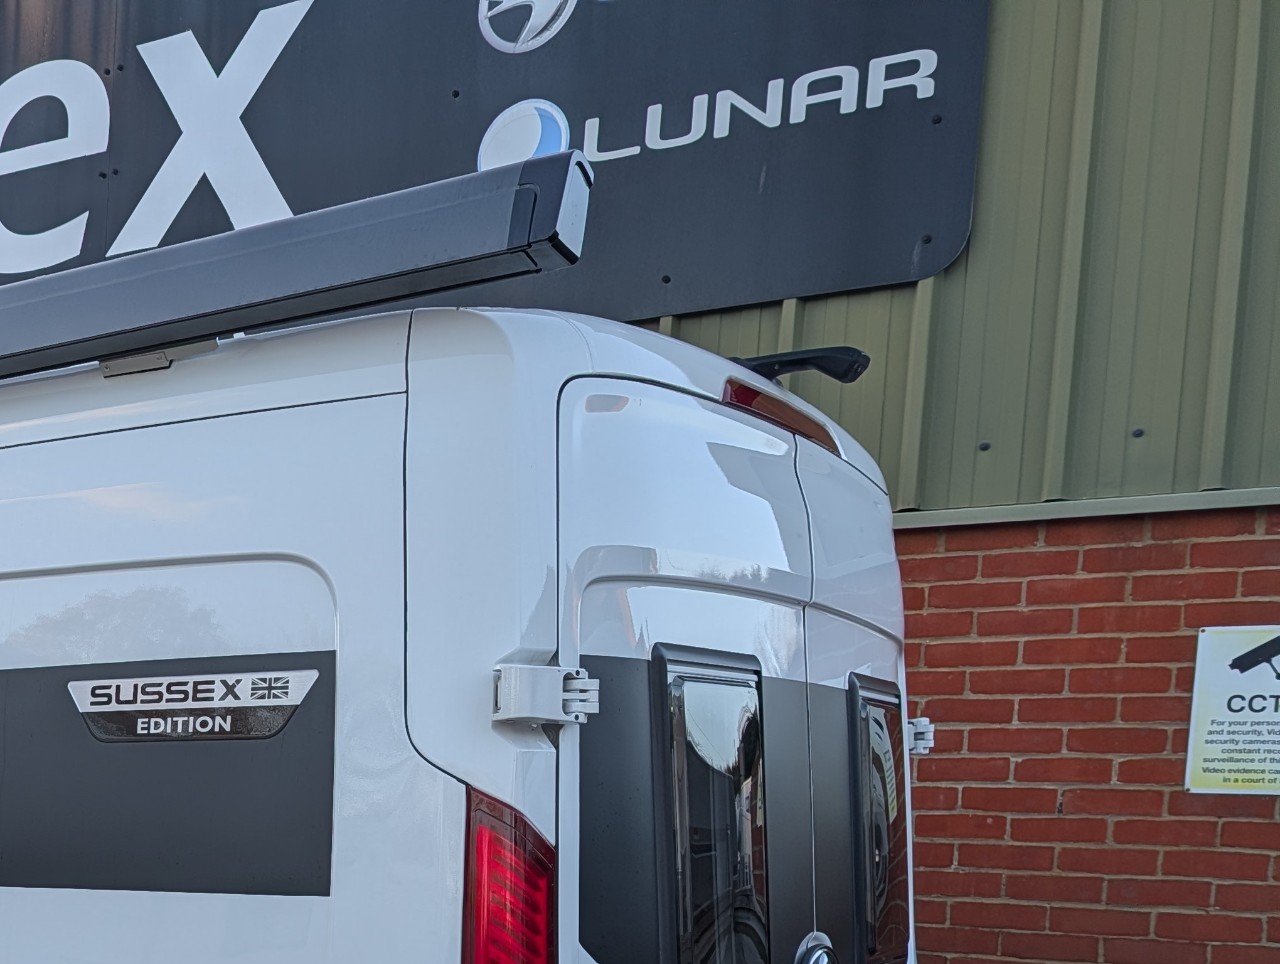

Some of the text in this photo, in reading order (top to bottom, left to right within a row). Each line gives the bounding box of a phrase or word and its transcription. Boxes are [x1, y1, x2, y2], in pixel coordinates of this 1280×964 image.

[583, 49, 937, 162] LUNAR
[89, 678, 243, 707] SUSSEX
[136, 715, 232, 734] EDITION
[1210, 719, 1227, 727] For
[1228, 720, 1249, 728] your
[1204, 738, 1240, 746] security
[1201, 766, 1226, 774] Video
